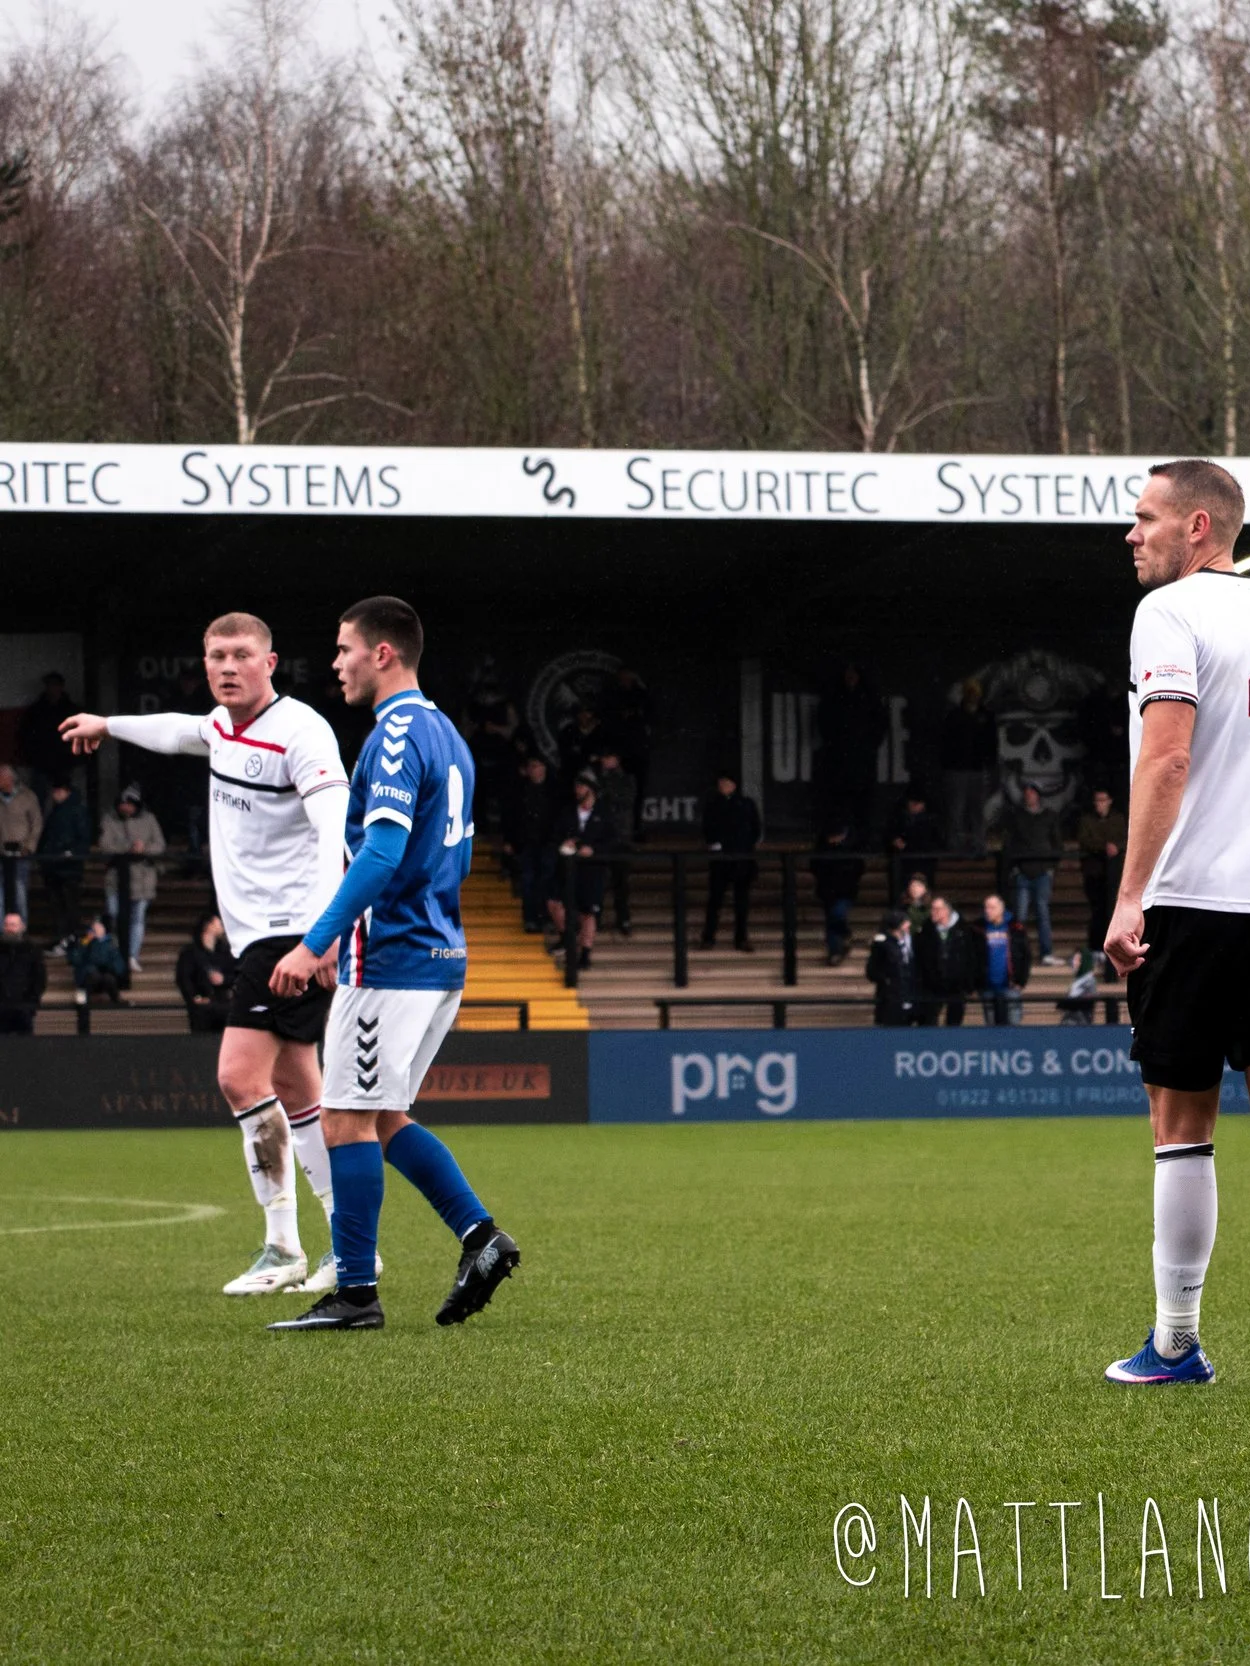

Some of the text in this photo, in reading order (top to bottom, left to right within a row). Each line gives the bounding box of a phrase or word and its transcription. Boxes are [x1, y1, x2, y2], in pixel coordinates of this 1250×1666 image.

[181, 451, 402, 508] SYSTEMS
[626, 457, 880, 514] SECURITEC
[671, 1051, 798, 1115] prg
[894, 1050, 1034, 1078] ROOFING
[1041, 1048, 1063, 1076] &
